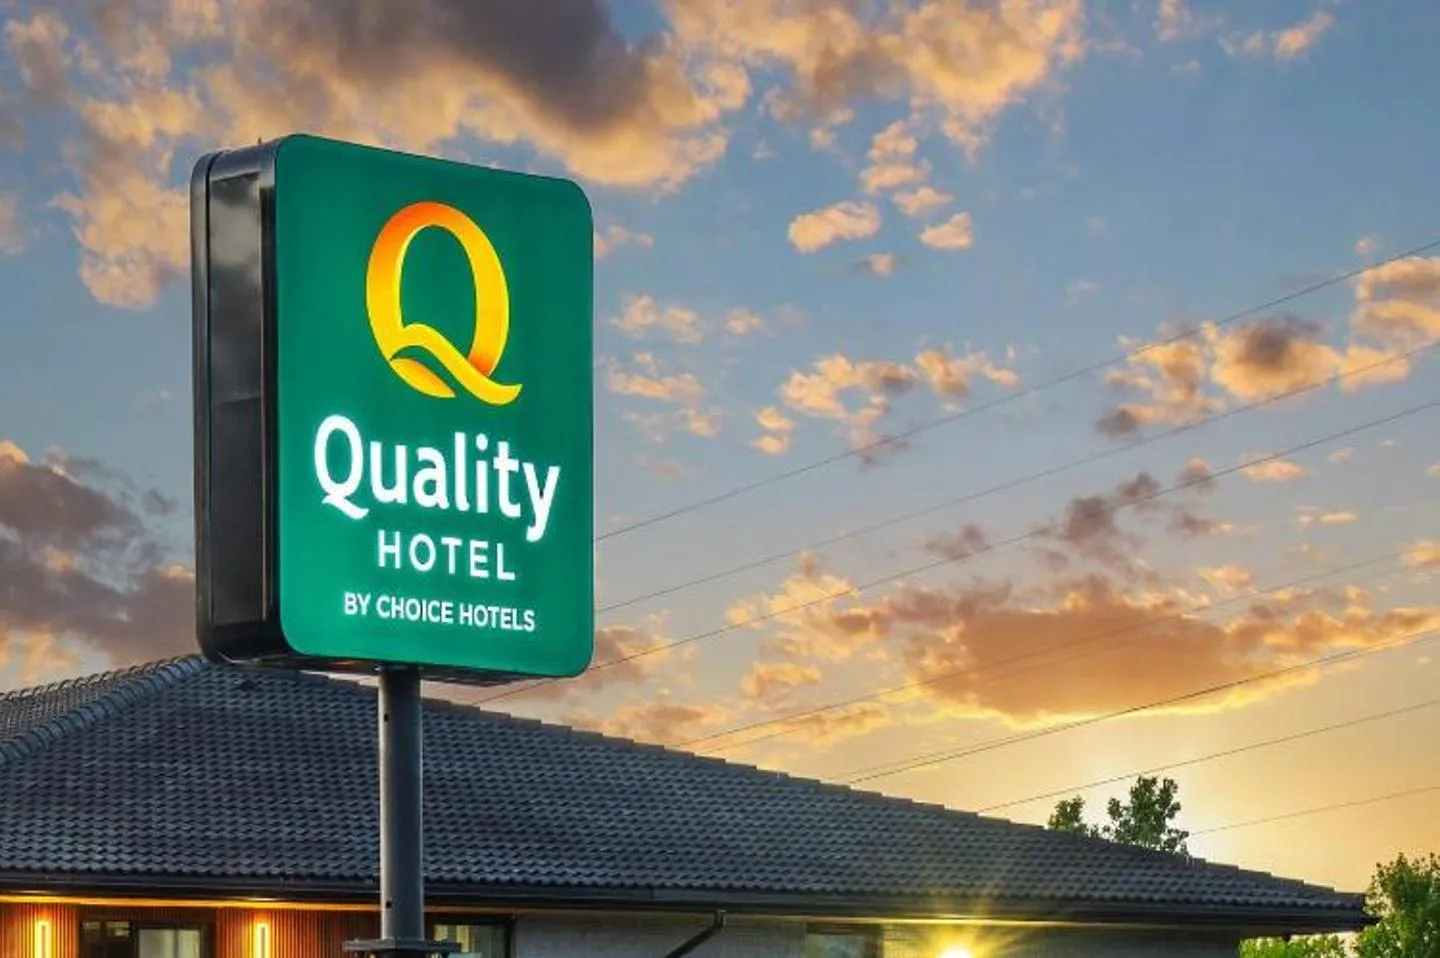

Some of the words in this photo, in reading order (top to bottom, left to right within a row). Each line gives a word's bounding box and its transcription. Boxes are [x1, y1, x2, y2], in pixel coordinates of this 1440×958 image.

[366, 201, 523, 405] Q
[313, 414, 561, 541] Quality
[377, 529, 516, 581] HOTEL
[344, 592, 369, 616] BY
[375, 595, 454, 625] CHOICE
[460, 602, 536, 633] HOTELS
